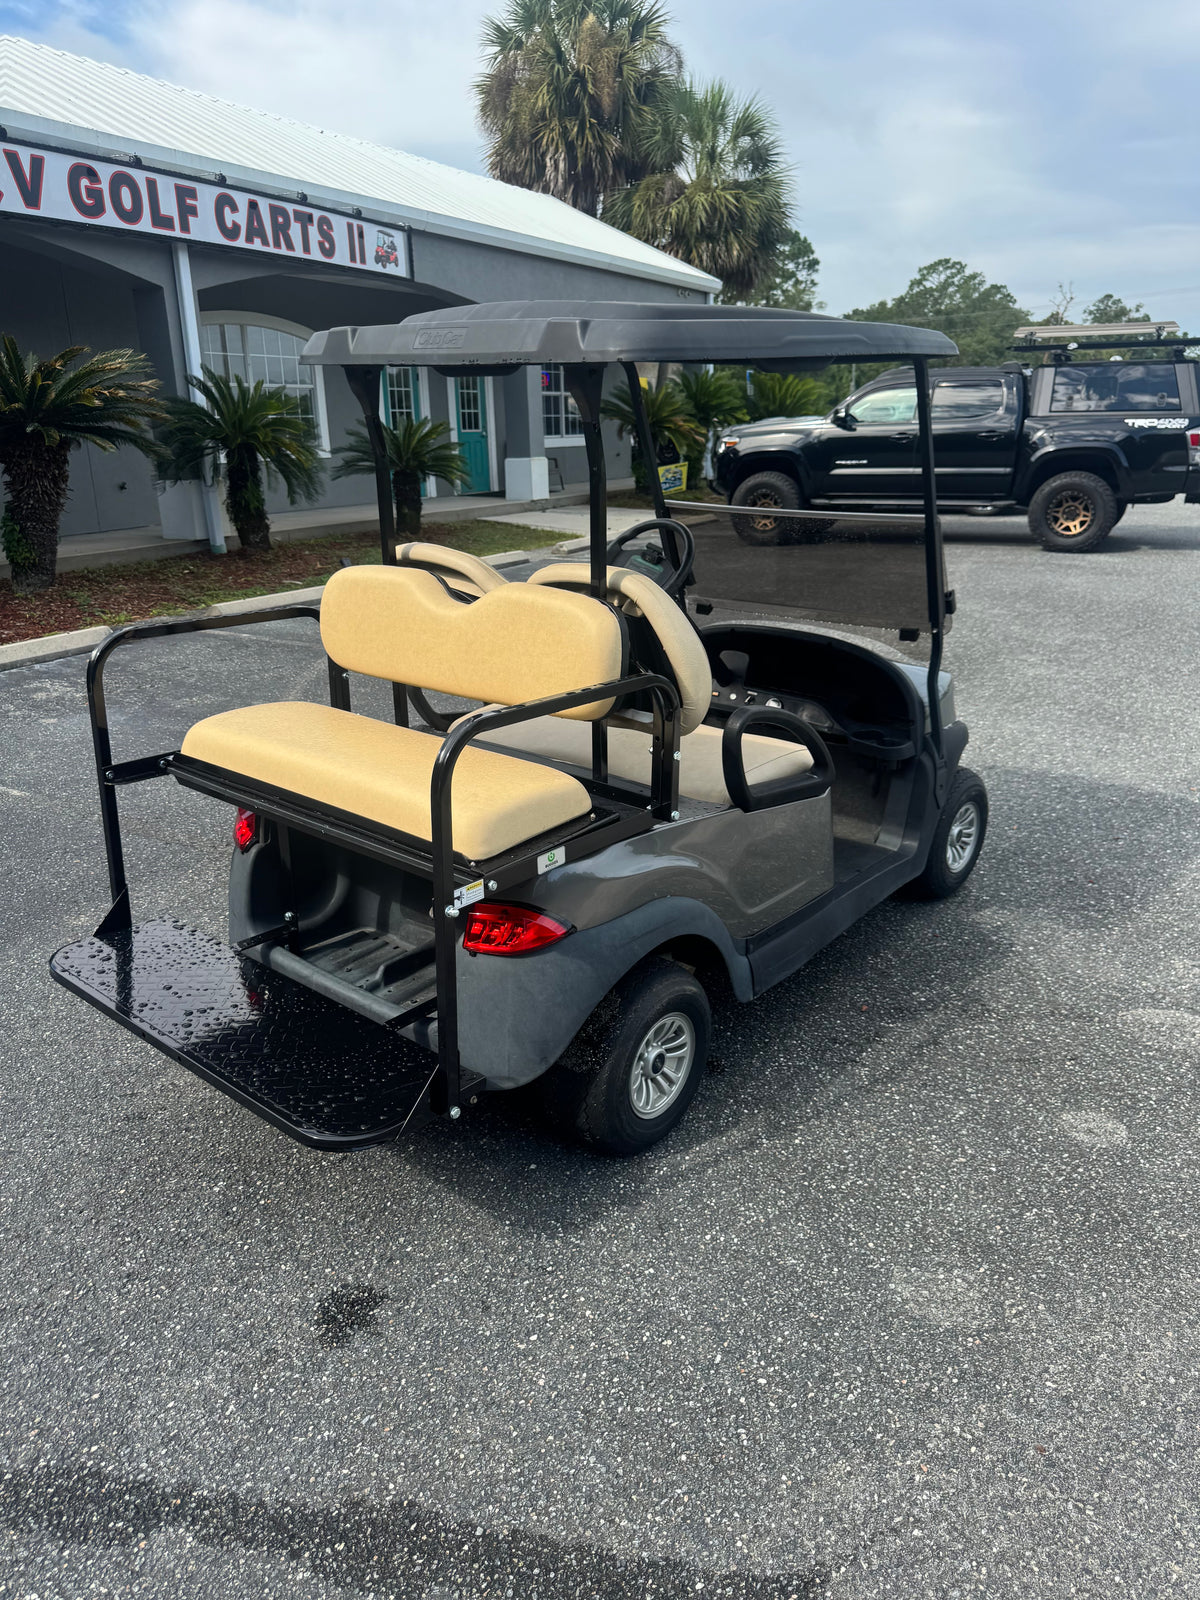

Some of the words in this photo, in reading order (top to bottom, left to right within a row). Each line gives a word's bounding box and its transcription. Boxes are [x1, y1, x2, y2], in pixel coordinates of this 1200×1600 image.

[0, 148, 46, 211] V
[67, 162, 199, 235] GOLF
[214, 192, 336, 260] CARTS
[346, 221, 367, 266] II
